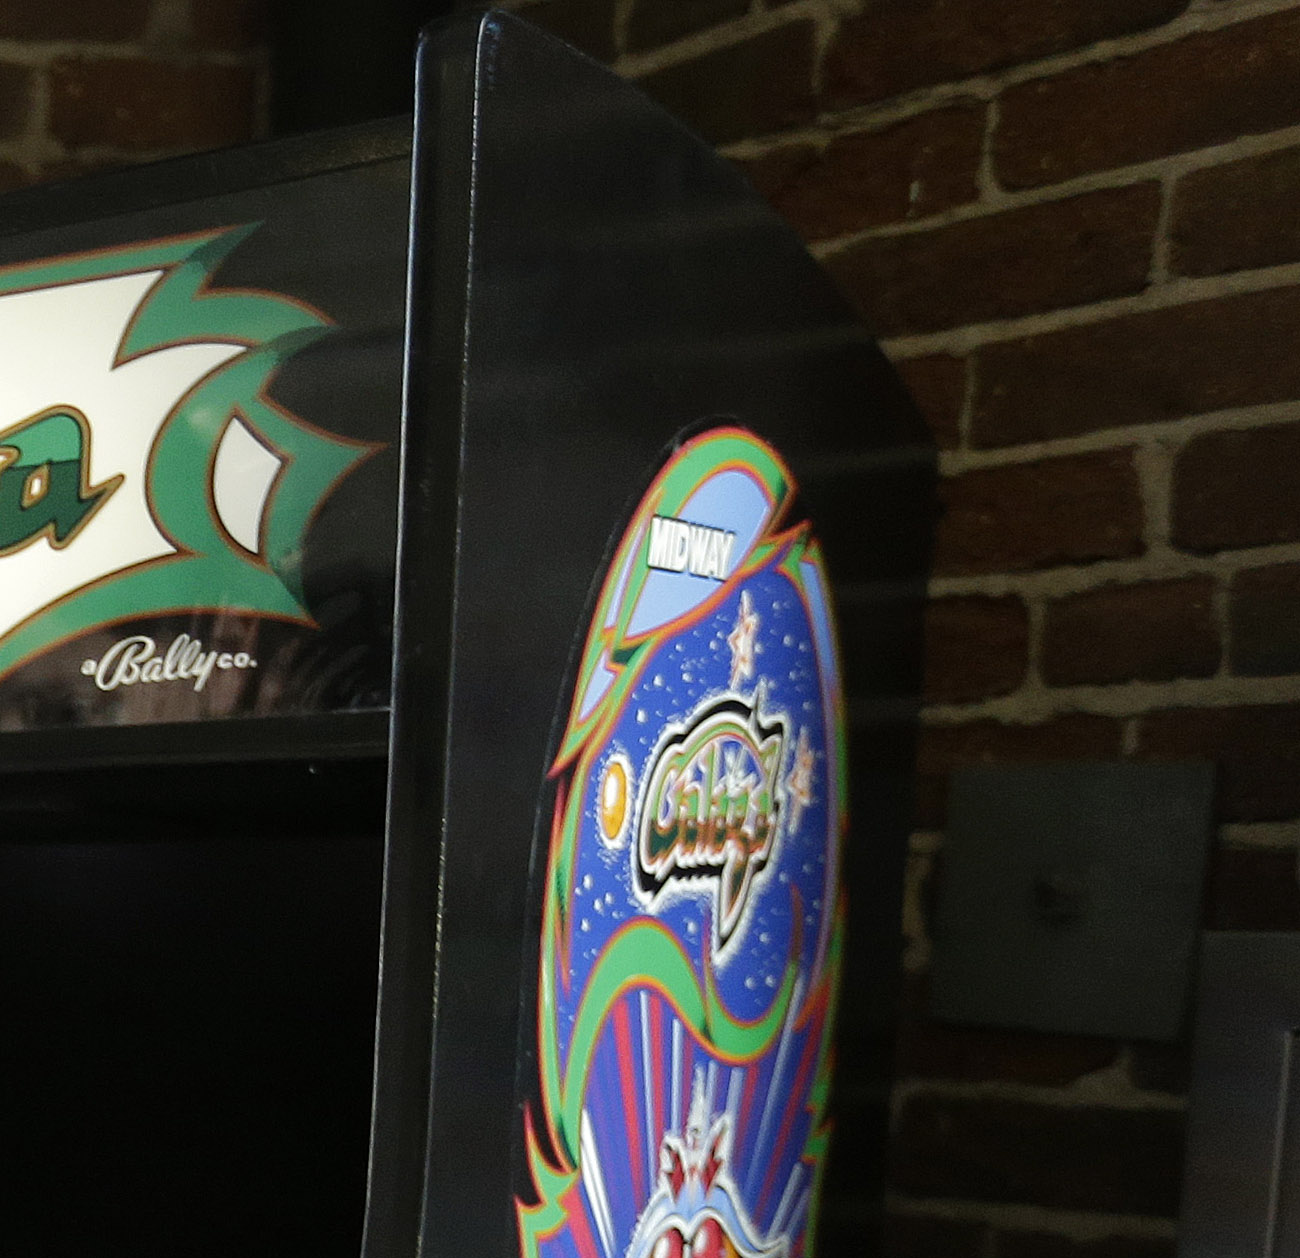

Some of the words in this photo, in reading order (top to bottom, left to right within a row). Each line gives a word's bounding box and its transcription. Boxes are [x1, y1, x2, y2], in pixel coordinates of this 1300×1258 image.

[647, 513, 736, 582] MIDWAY
[80, 658, 98, 676] a
[95, 633, 219, 692] Bally
[216, 651, 259, 670] co.
